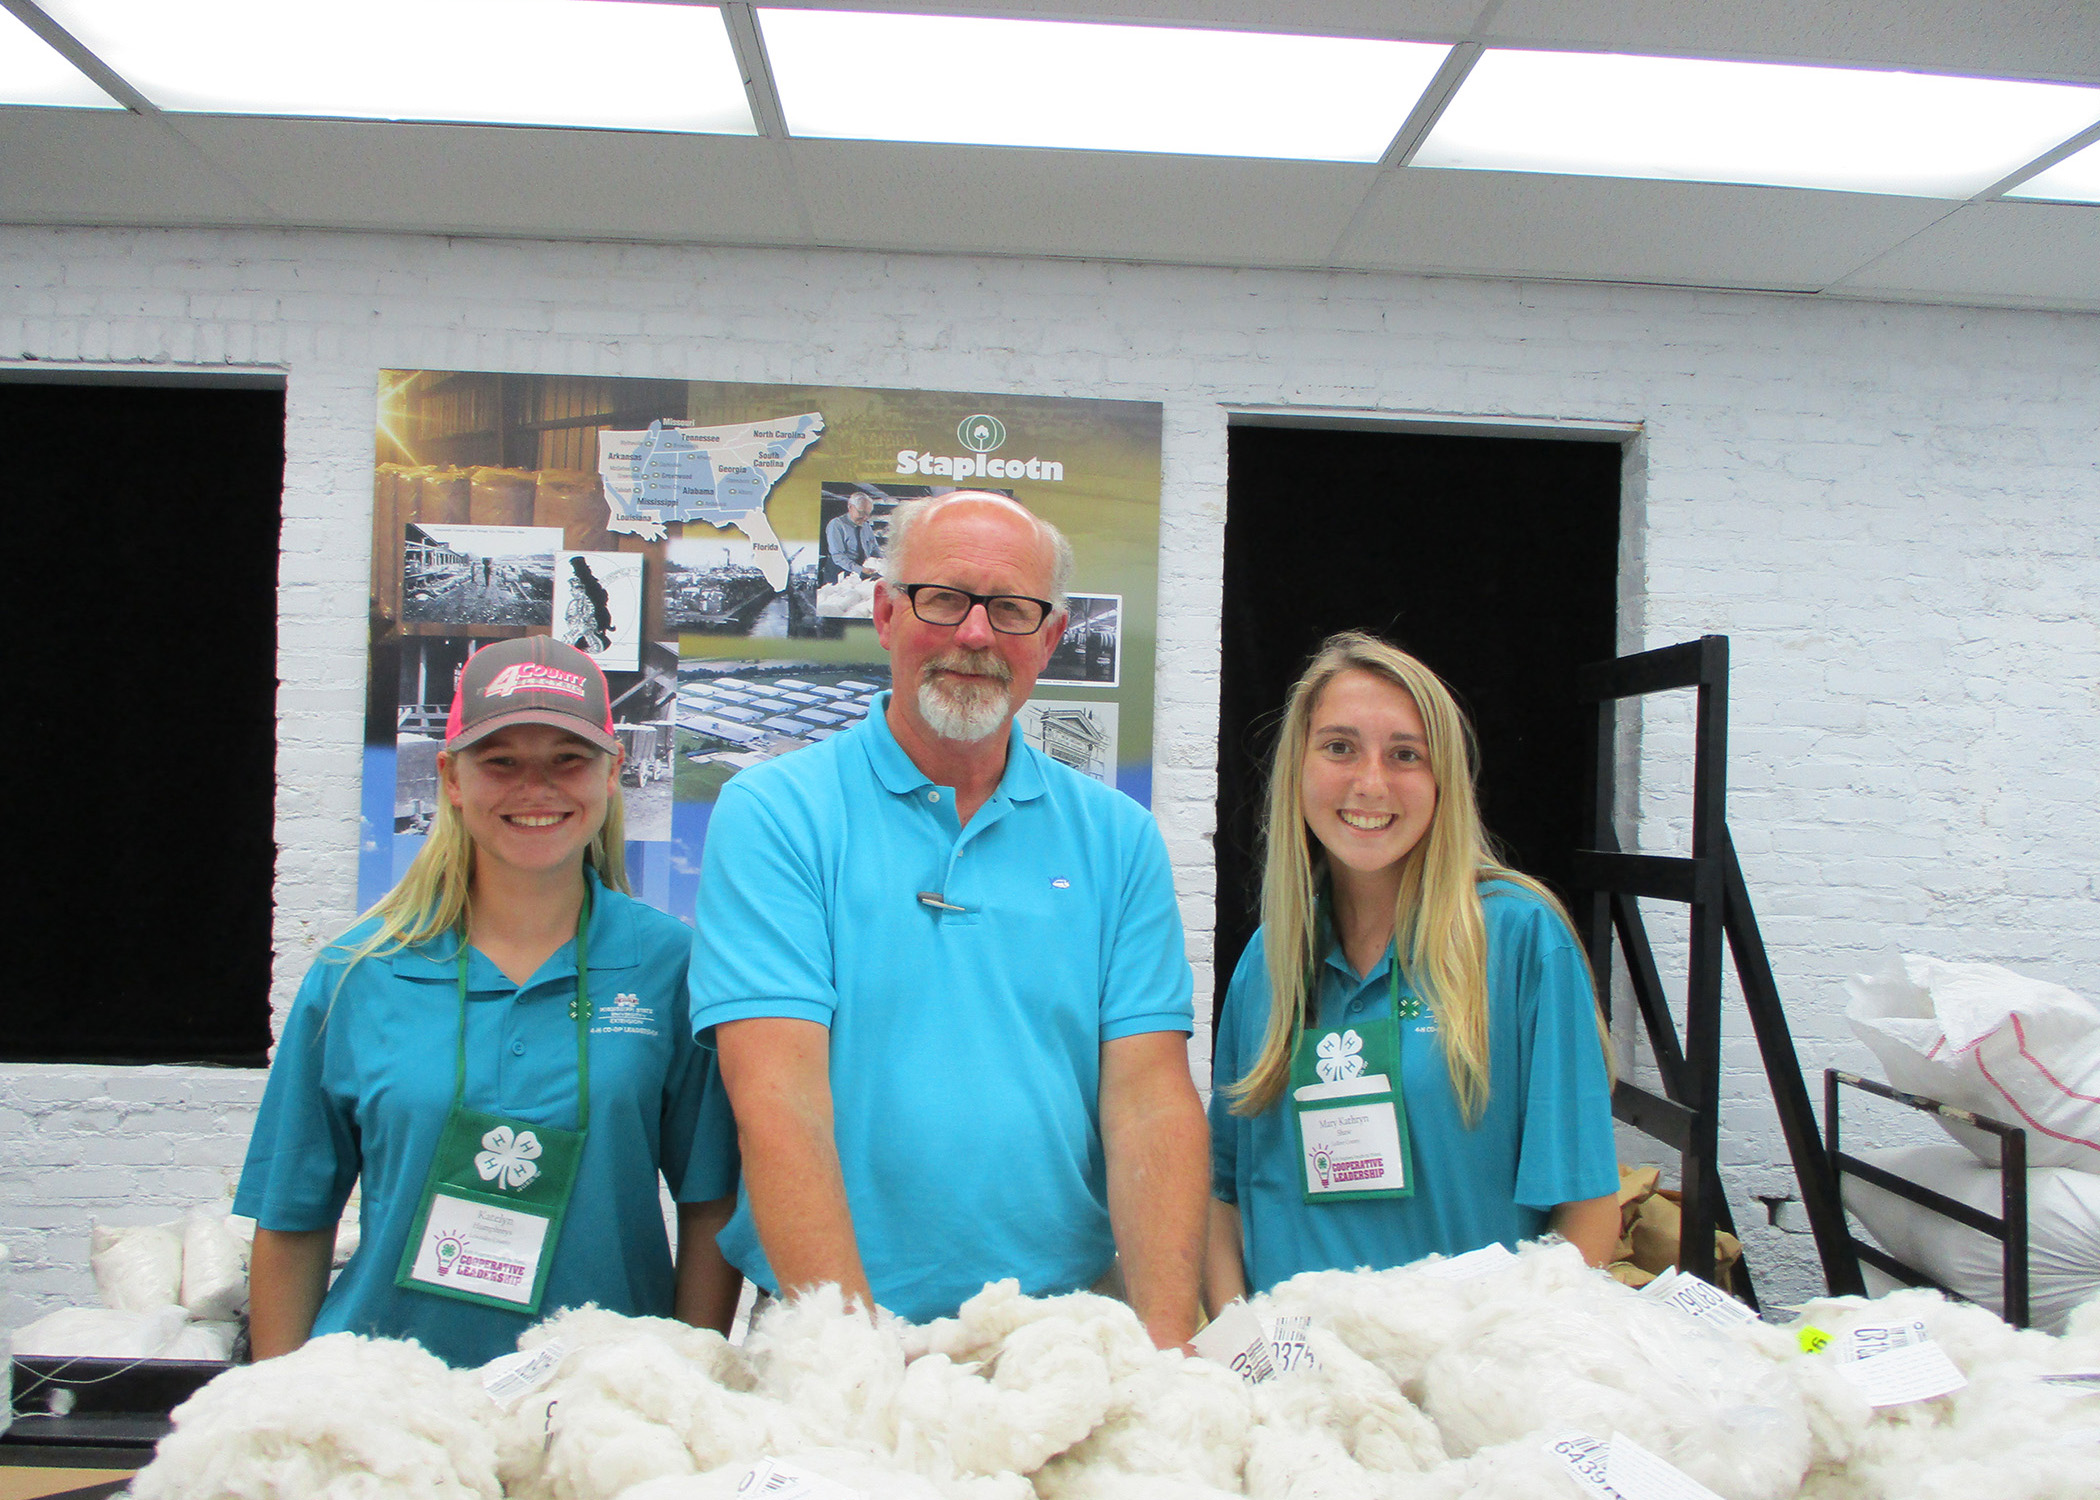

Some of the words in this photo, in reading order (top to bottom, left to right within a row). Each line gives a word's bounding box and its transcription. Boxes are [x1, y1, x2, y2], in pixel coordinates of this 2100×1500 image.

[663, 417, 695, 426] Missouri
[682, 433, 720, 442] Tennessee
[775, 430, 806, 439] Carolina
[608, 452, 642, 460] Arkansas
[758, 450, 780, 459] South
[753, 459, 784, 468] Carolina
[896, 450, 1064, 481] Staplcotn
[718, 464, 747, 474] Georgia
[682, 486, 714, 496] Alabama
[636, 497, 679, 509] Mississippi
[616, 513, 652, 522] Louisiana
[752, 542, 779, 551] Florida
[1332, 1158, 1384, 1172] COOPERATIVE
[1333, 1168, 1385, 1182] LEADERSHIP
[460, 1255, 525, 1276] COOPERATIVE
[456, 1264, 522, 1286] LEADERSHIP
